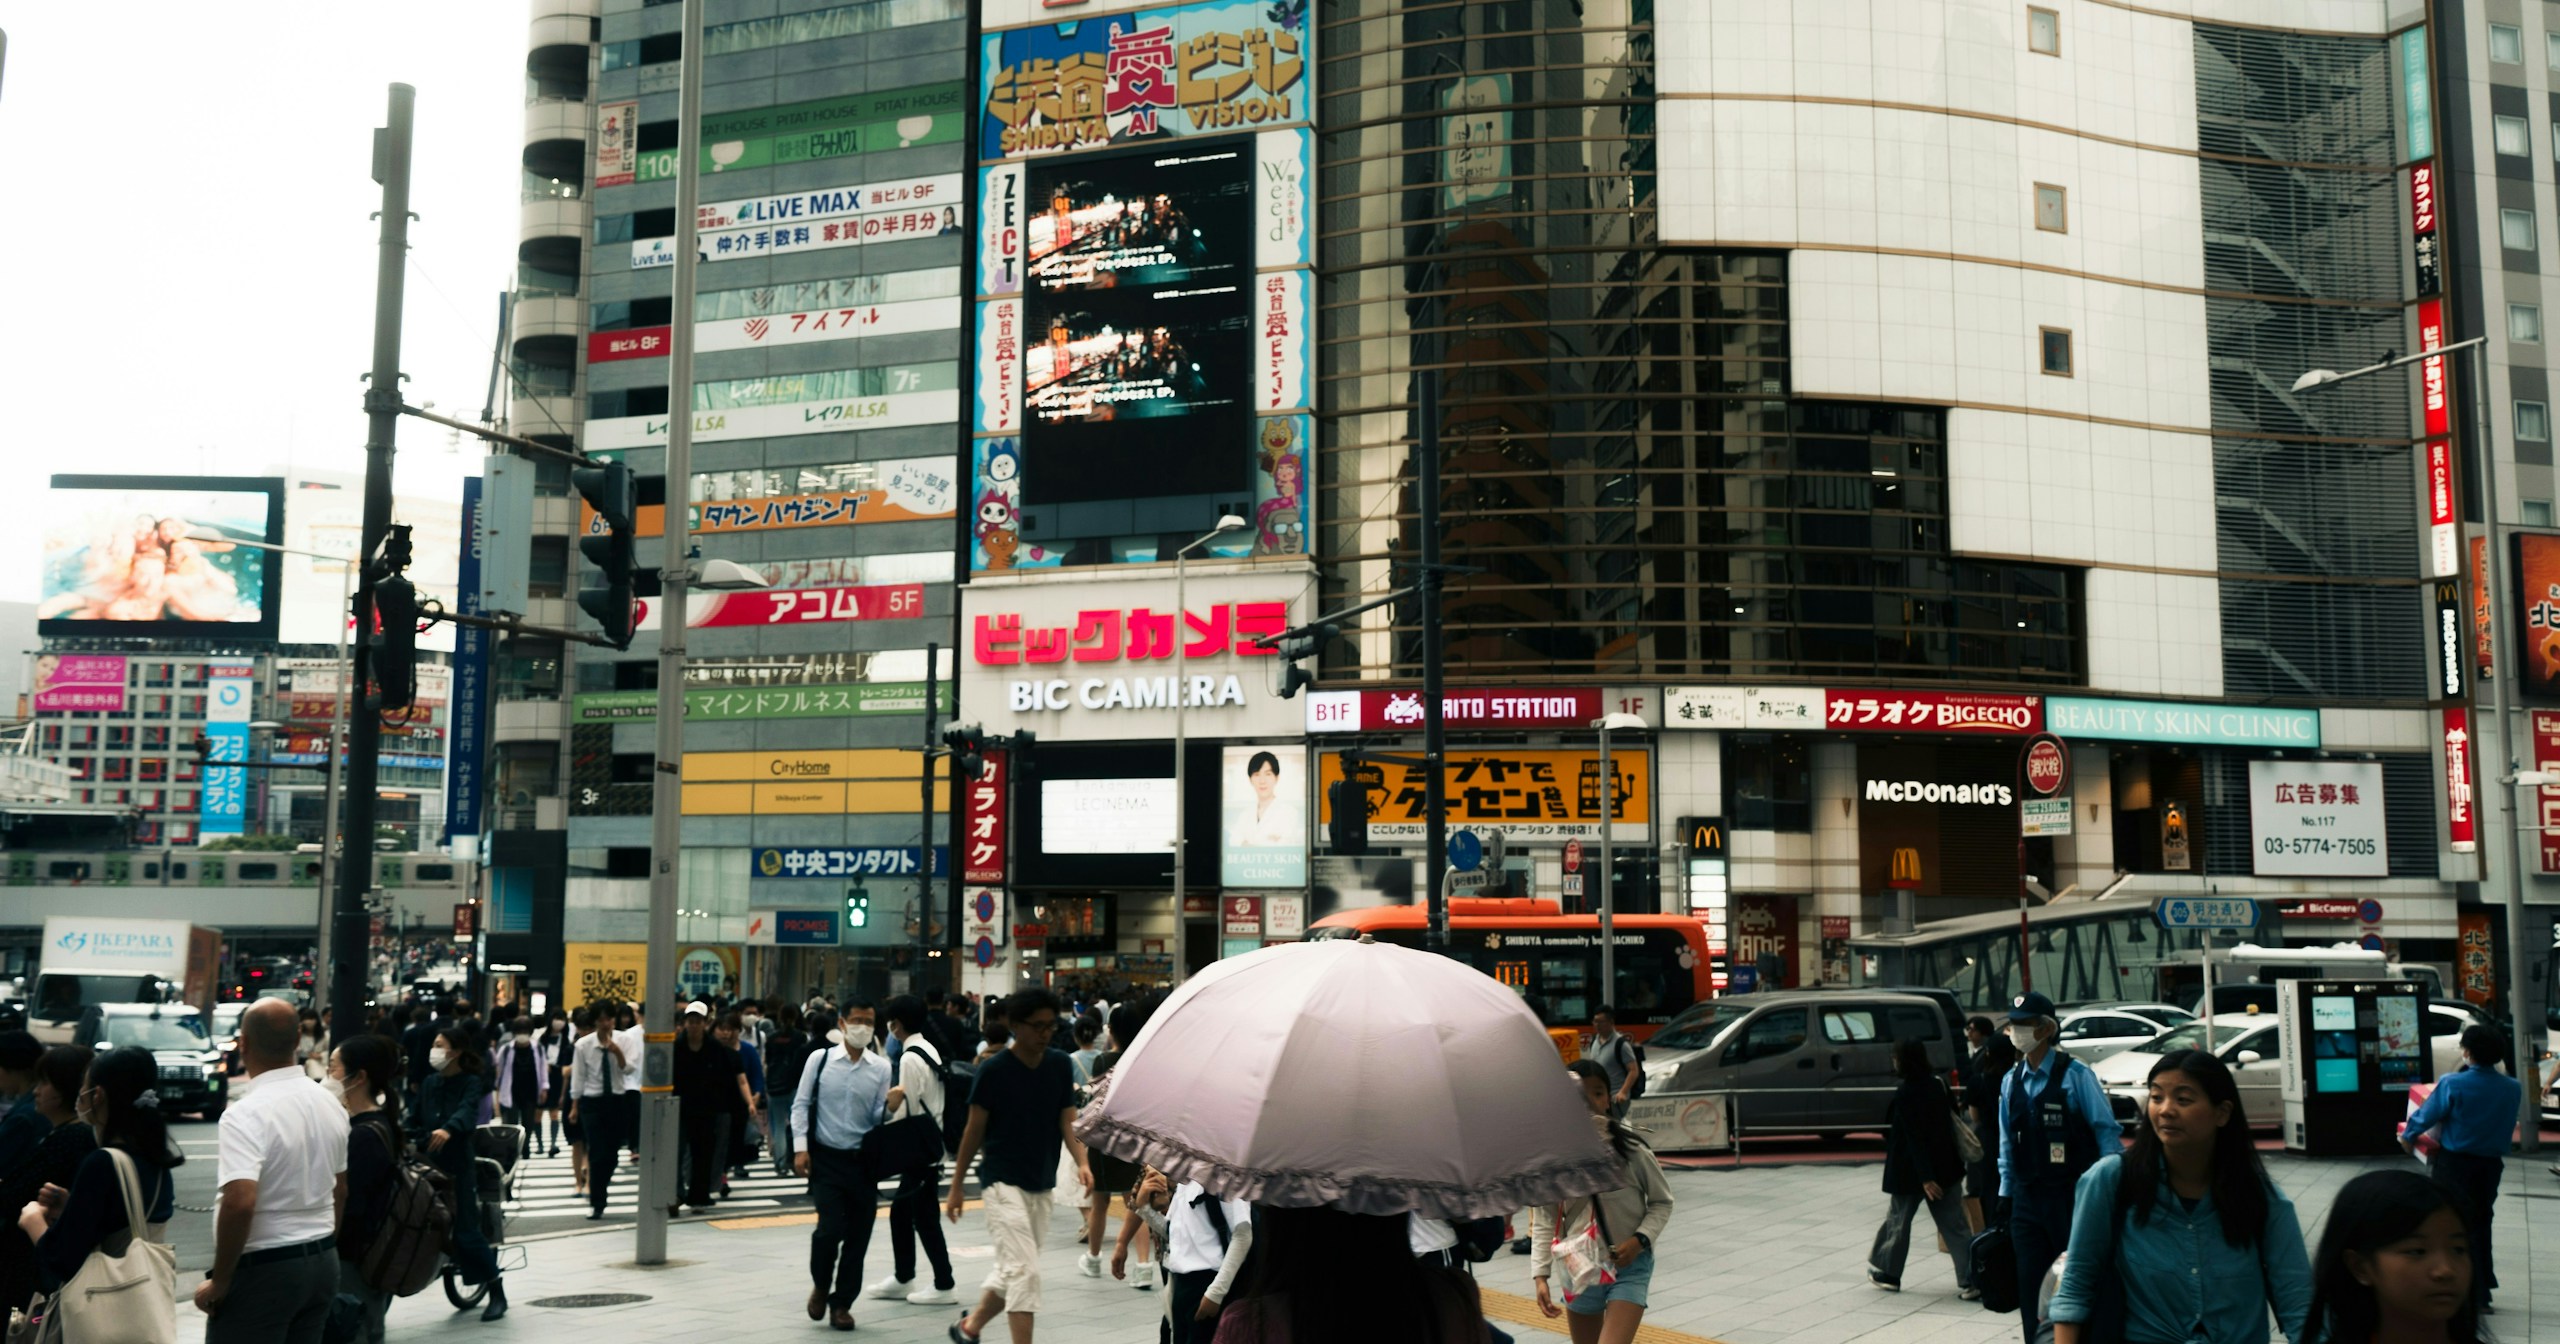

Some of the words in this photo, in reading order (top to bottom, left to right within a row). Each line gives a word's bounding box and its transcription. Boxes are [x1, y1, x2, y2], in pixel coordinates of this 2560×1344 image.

[1126, 110, 1158, 136] AI
[1186, 95, 1290, 131] VISION
[1000, 121, 1111, 152] SHIBUYA
[810, 189, 861, 216] MAX
[913, 184, 935, 199] 9F
[2414, 168, 2433, 230] カラオケ
[716, 225, 810, 254] 仲介手数料
[823, 212, 937, 241] 家賃の半月分
[1002, 174, 1017, 284] ZECT
[791, 307, 880, 333] アイフル
[641, 335, 660, 350] 8F
[894, 370, 921, 392] 7F
[805, 401, 889, 423] レイクALSA
[2432, 446, 2444, 466] BIC
[901, 462, 951, 494] いい部屋
[2434, 468, 2448, 519] CAMERA
[768, 589, 859, 623] アコム
[889, 590, 919, 612] 5F
[974, 601, 1287, 665] ビックカメラ
[699, 692, 851, 714] マインドフルネス
[1009, 679, 1071, 713] BIC
[1080, 675, 1247, 711] CAMERA
[2025, 695, 2039, 707] 6F
[1316, 703, 1350, 721] B1F
[1442, 698, 1484, 719] AITO
[1492, 697, 1576, 718] STATION
[1829, 699, 1934, 725] カラオケ
[2054, 706, 2148, 732] BEAUTY
[2154, 709, 2212, 736] SKIN
[2219, 713, 2312, 741] CLINIC
[1584, 763, 1615, 773] GAE
[2031, 757, 2060, 777] 消火栓
[1866, 779, 2013, 806] McDonald's
[2452, 743, 2471, 822] GAME
[581, 788, 599, 806] 3F
[2275, 783, 2360, 805] 広告募集
[971, 760, 998, 866] カラオケ
[2301, 815, 2336, 827] No.117
[2265, 837, 2376, 856] 03-5774-7505
[784, 849, 916, 874] 中央コンタクト
[1226, 853, 1271, 865] BEAUTY
[1273, 853, 1302, 865] SKIN
[1243, 867, 1285, 880] CLINIC
[2172, 906, 2188, 918] 305
[2193, 901, 2246, 917] 明治通り
[2309, 903, 2357, 914] BicCamera
[93, 932, 174, 947] IKEPARA
[1505, 935, 1542, 946] SHIBUYA
[1544, 936, 1589, 948] community
[1612, 936, 1645, 946] ACHIKO
[2463, 929, 2490, 993] 北海道
